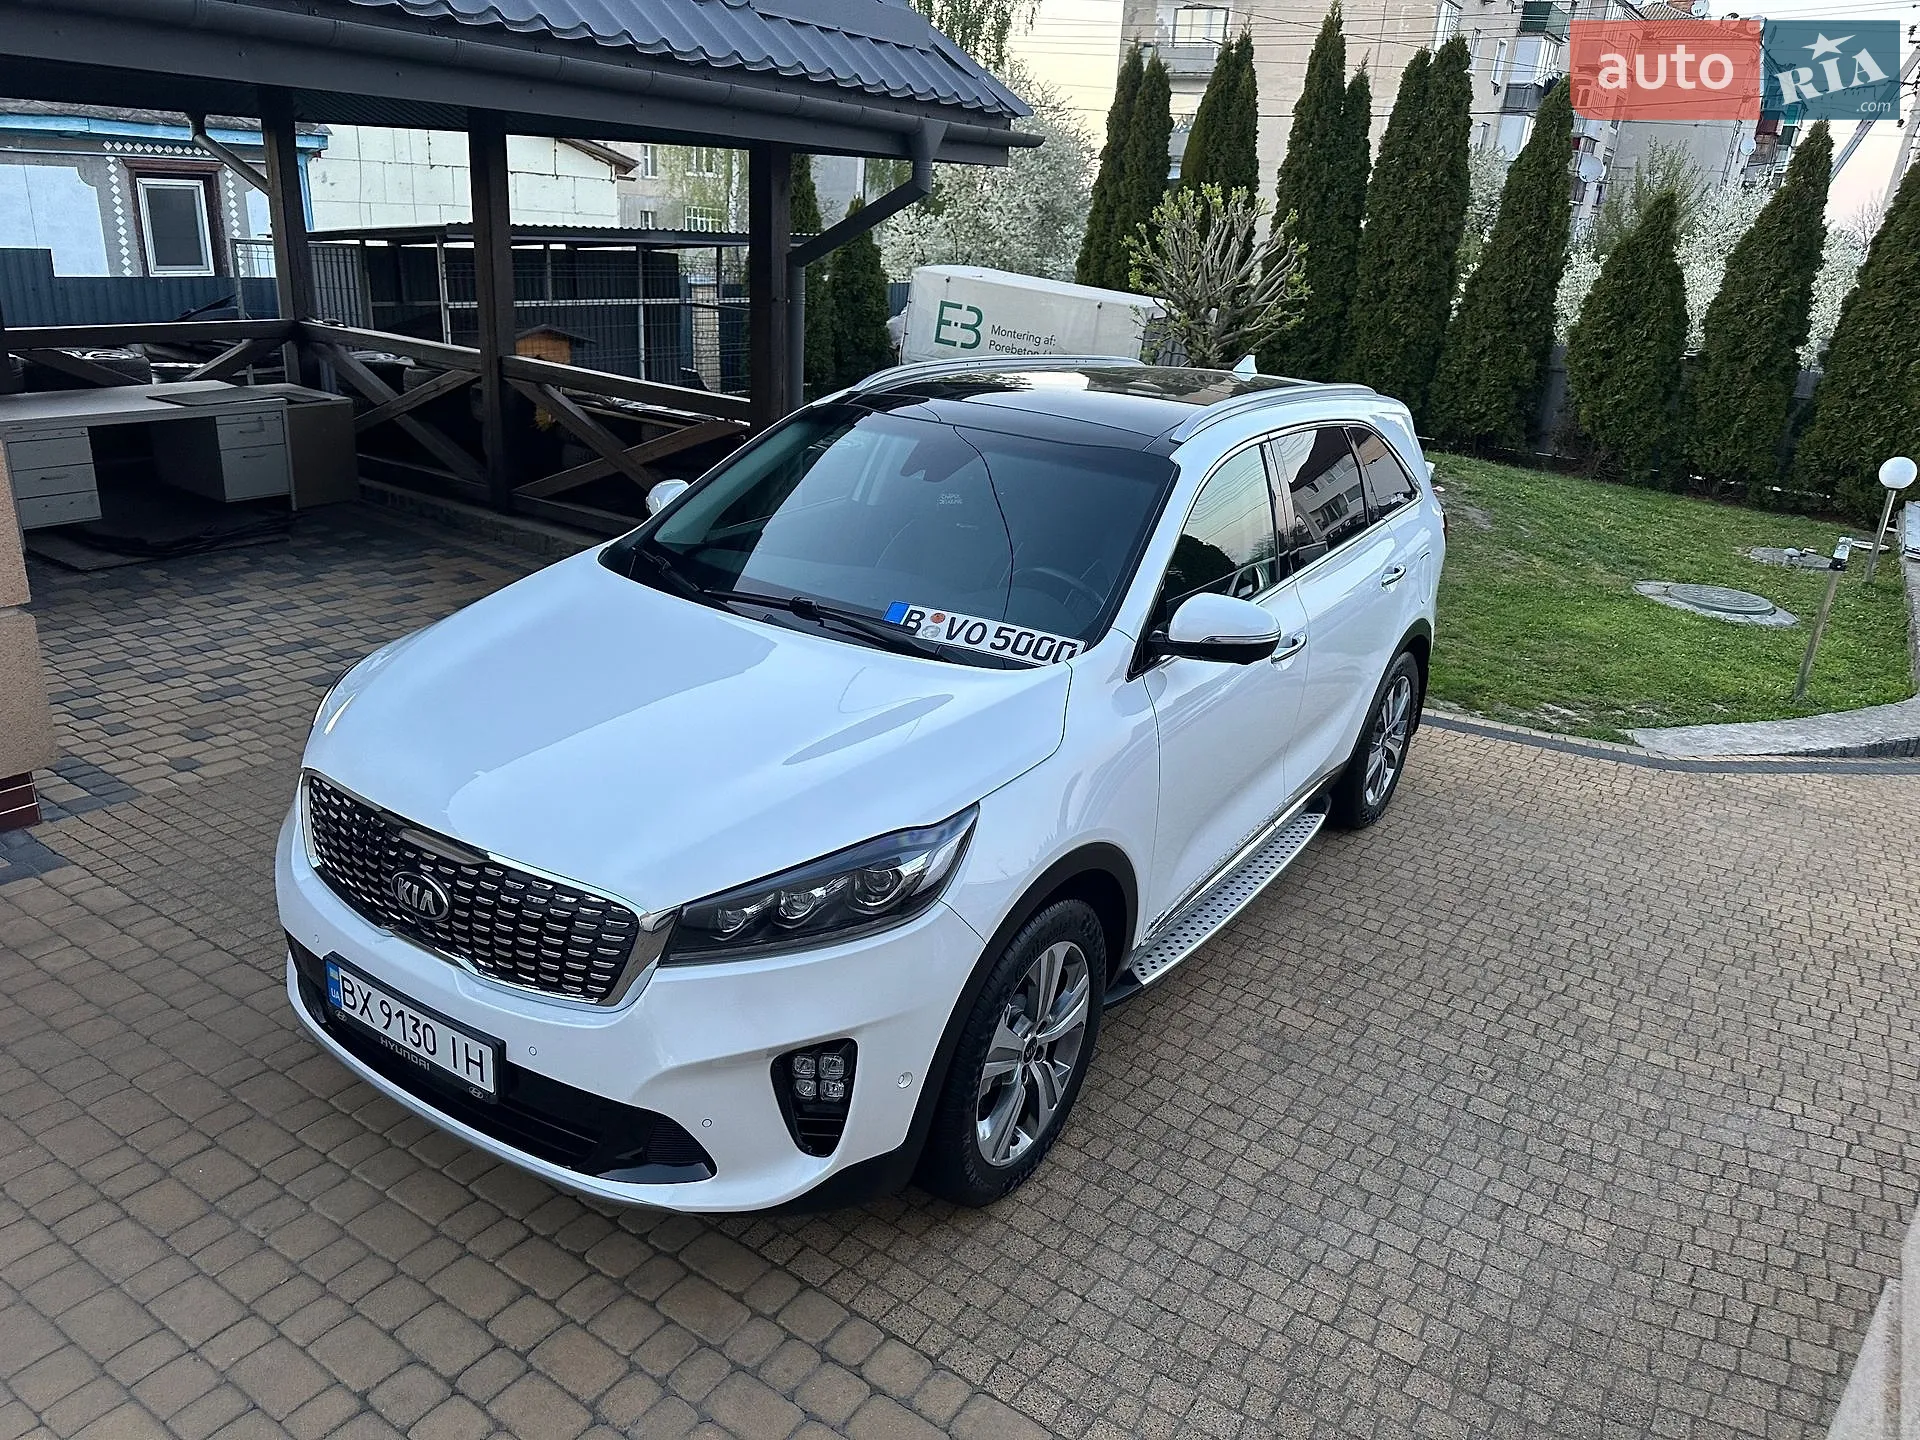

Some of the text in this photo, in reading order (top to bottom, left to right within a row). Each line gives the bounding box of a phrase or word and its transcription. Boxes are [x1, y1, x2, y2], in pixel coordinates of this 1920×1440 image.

[991, 324, 1057, 347] Montering af:
[903, 609, 1078, 665] B VO 5000
[397, 877, 437, 915] KIA
[340, 974, 485, 1083] BX 9130 IH
[380, 1035, 431, 1071] HYUNDAI
